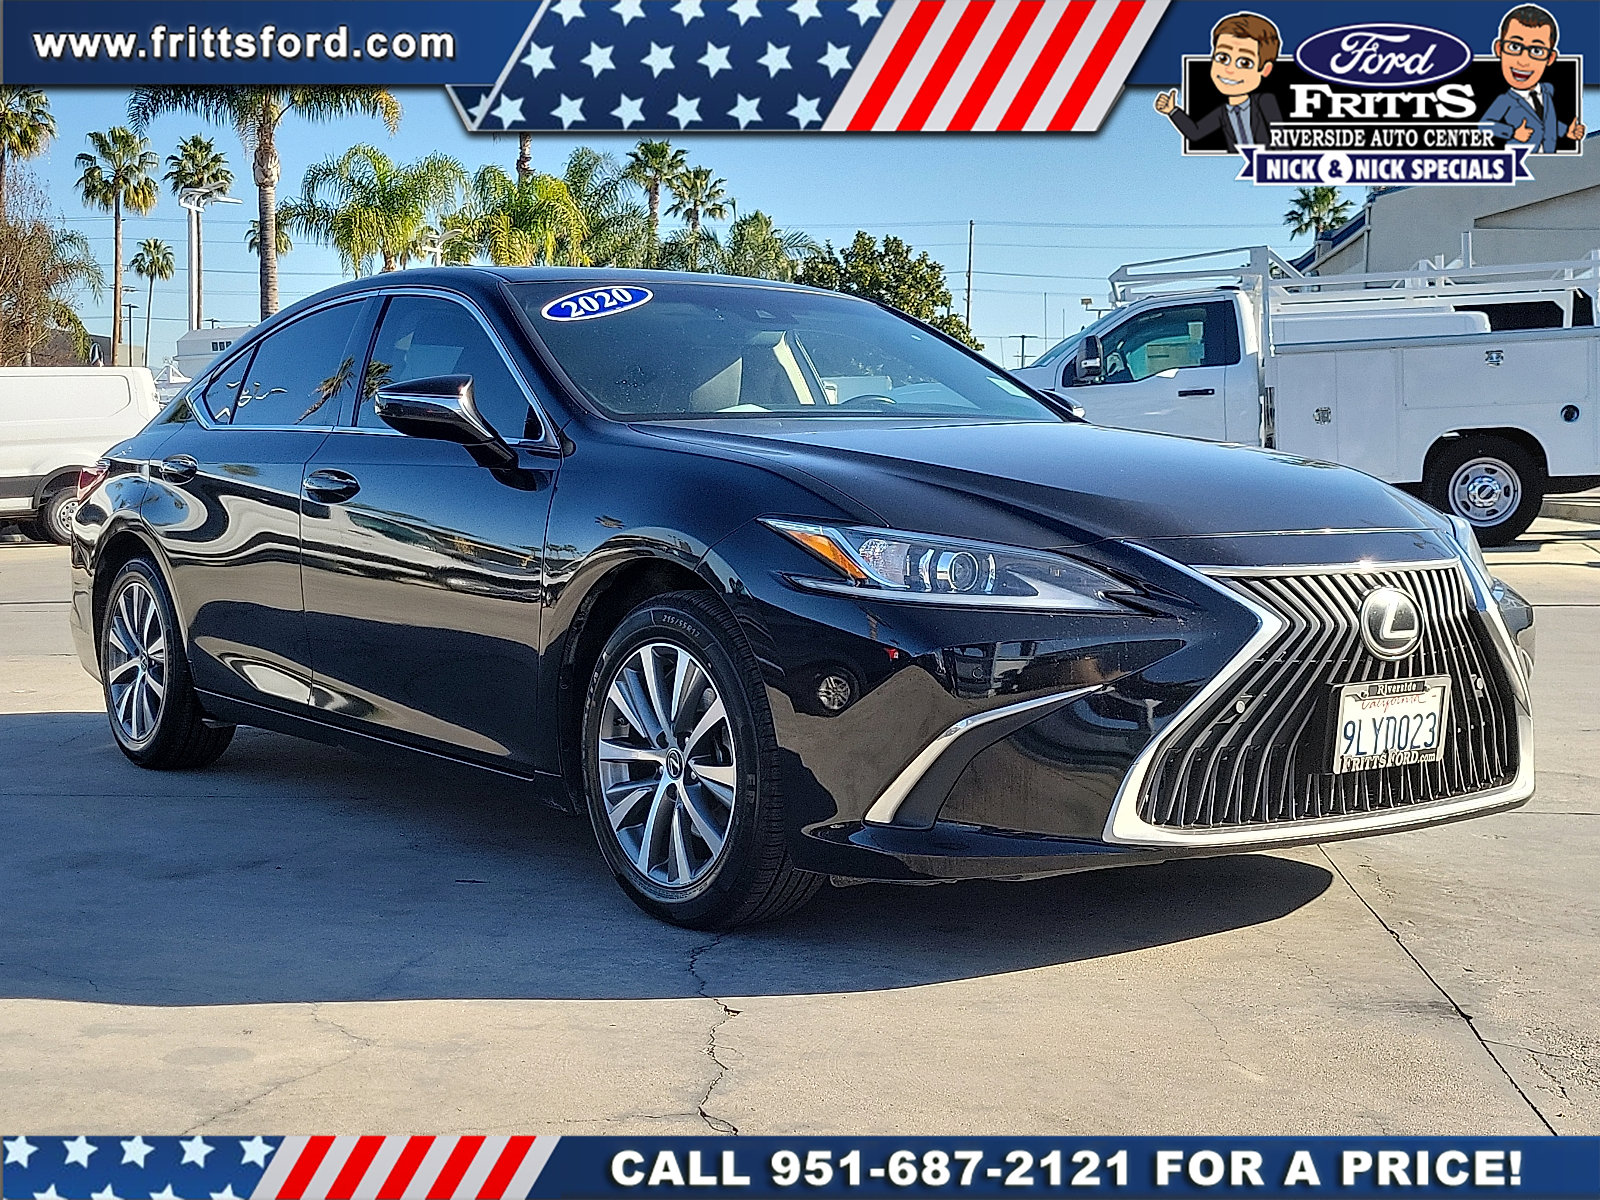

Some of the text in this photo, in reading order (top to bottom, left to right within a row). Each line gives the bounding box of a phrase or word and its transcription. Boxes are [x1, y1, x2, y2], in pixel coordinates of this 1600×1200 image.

[560, 287, 633, 318] 2020
[1376, 681, 1417, 696] Riverside
[1343, 711, 1437, 756] 9LYD023
